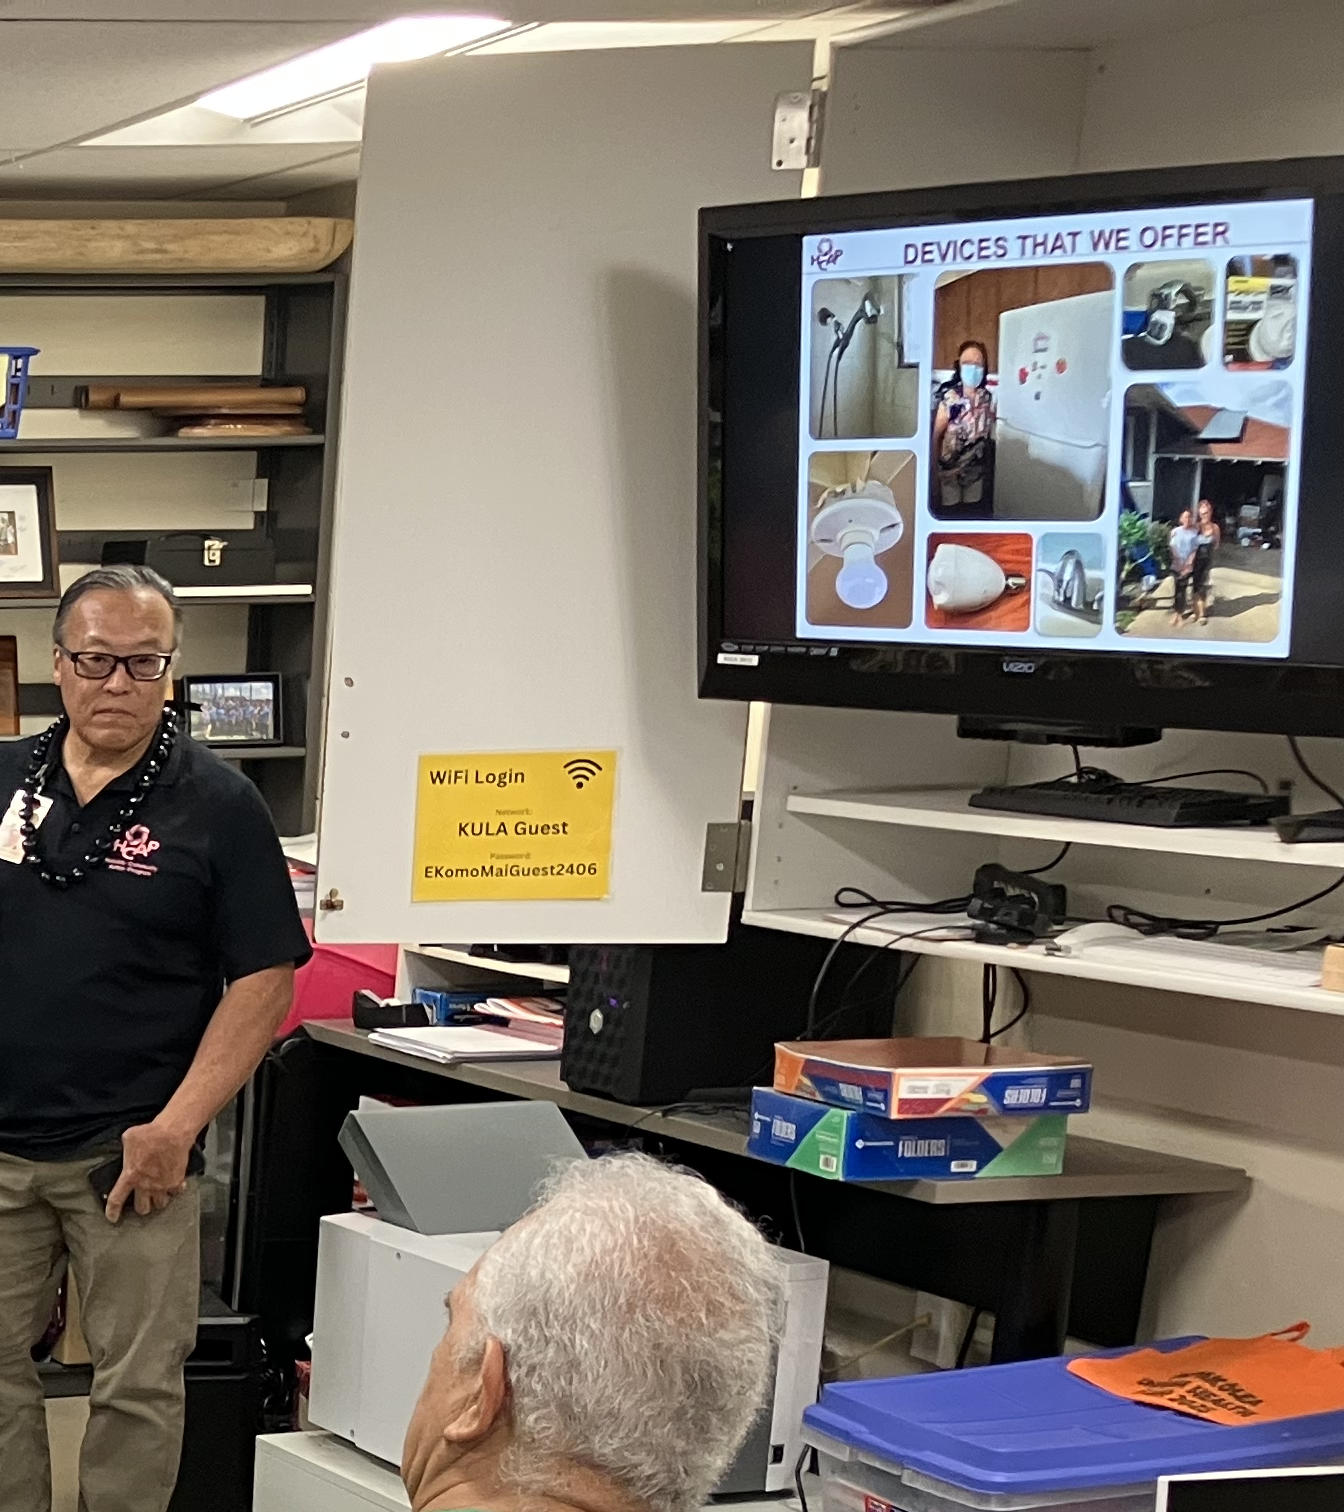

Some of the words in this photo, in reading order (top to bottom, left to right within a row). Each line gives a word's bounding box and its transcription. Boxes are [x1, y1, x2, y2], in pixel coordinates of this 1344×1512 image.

[903, 236, 1008, 265] DEVICES
[1017, 230, 1082, 256] THAT
[1088, 226, 1131, 252] WE
[1139, 221, 1231, 248] OFFER
[429, 769, 469, 785] WiFi
[475, 768, 525, 788] Login
[458, 821, 509, 837] KULA
[514, 821, 569, 836] Guest
[113, 839, 160, 860] HCAP
[424, 863, 598, 879] EKomoMaiGuest2406
